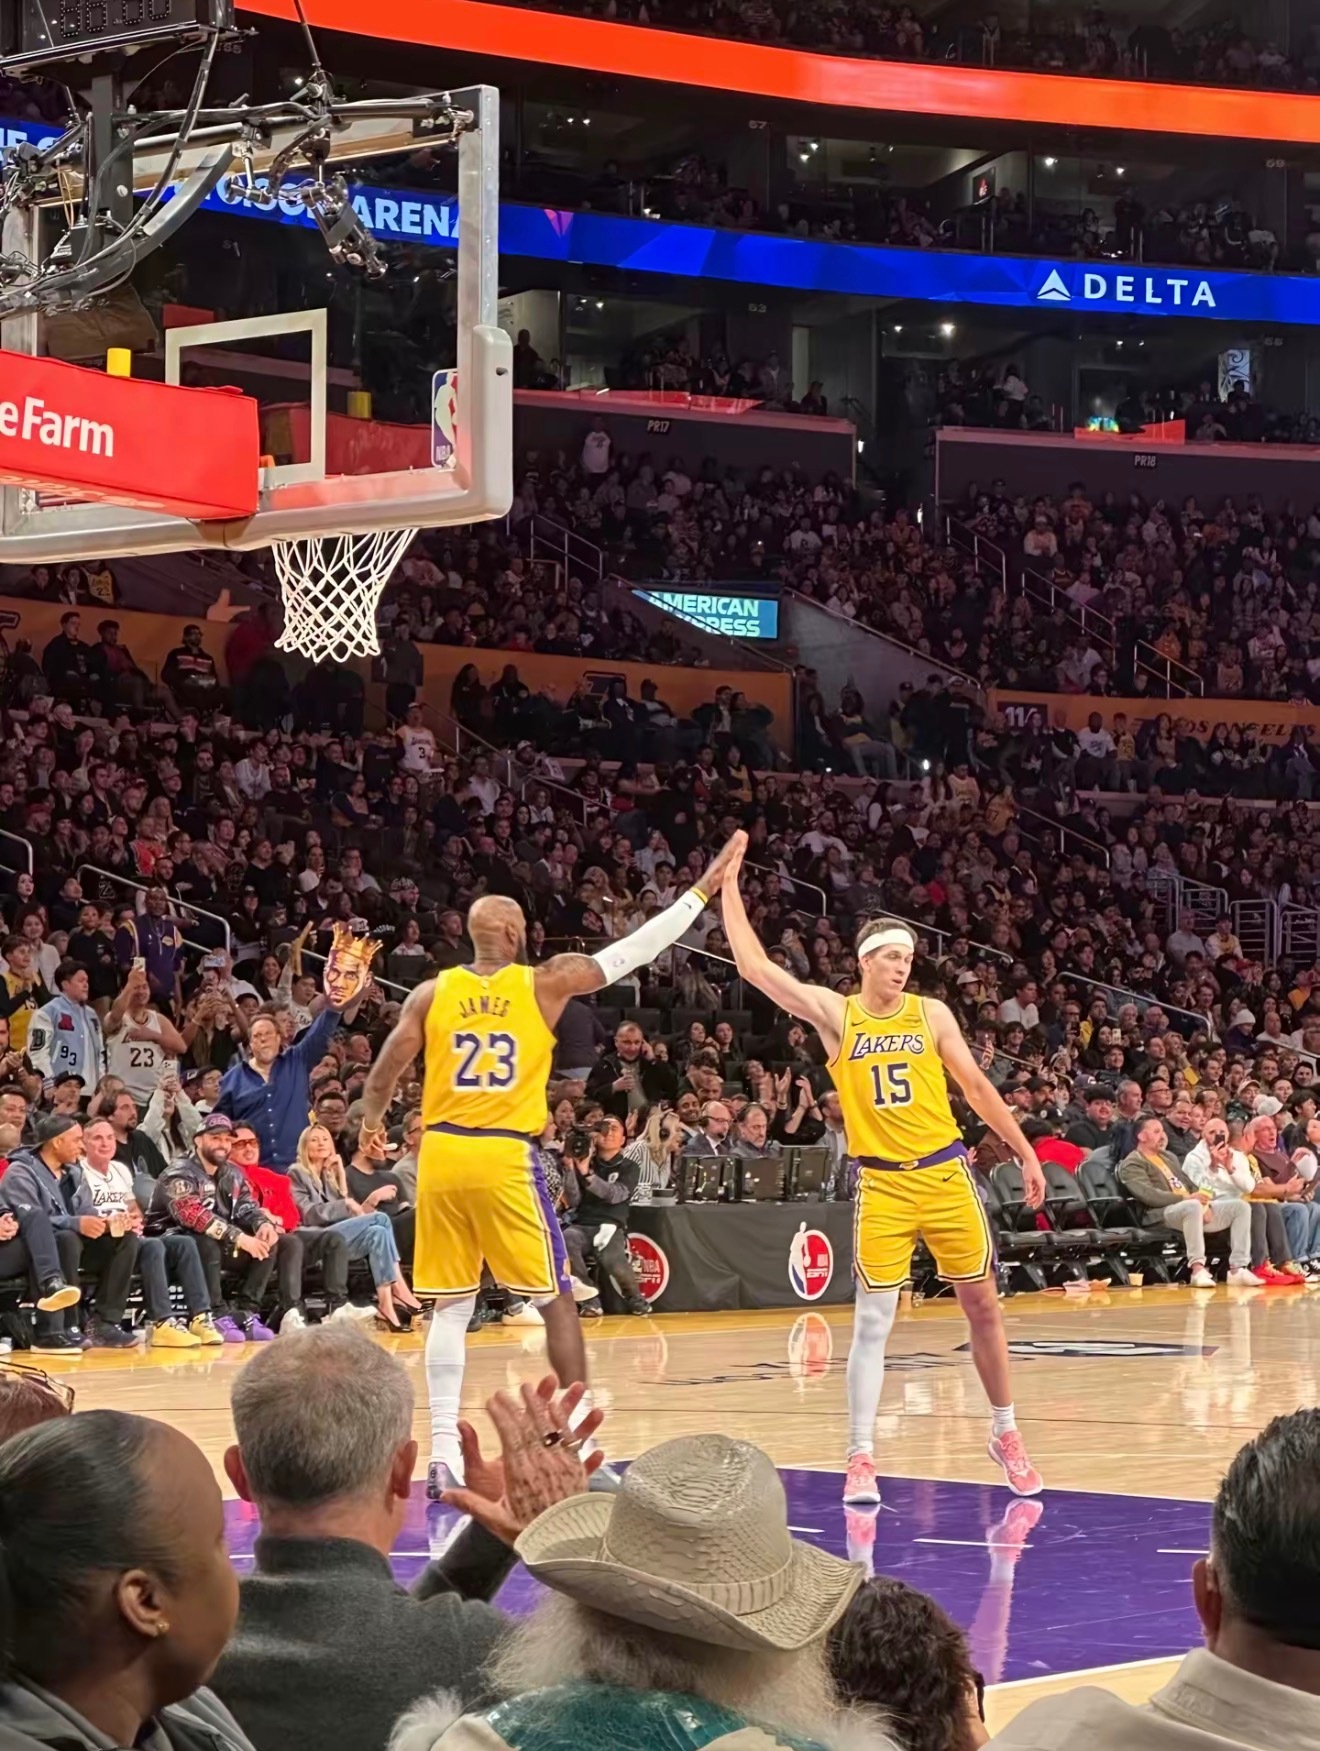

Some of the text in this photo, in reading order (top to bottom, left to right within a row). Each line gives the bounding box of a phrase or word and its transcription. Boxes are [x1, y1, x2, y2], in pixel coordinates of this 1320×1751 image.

[1084, 273, 1217, 307] DELTA
[646, 419, 670, 433] PR17
[1134, 455, 1157, 467] PR18
[649, 592, 759, 617] AMERICAN
[418, 747, 426, 759] 3
[459, 995, 511, 1018] JAMES
[130, 1047, 154, 1068] 23
[848, 1033, 925, 1061] LAKERS
[453, 1032, 516, 1088] 23
[871, 1063, 912, 1105] 15
[642, 1260, 661, 1273] NBA
